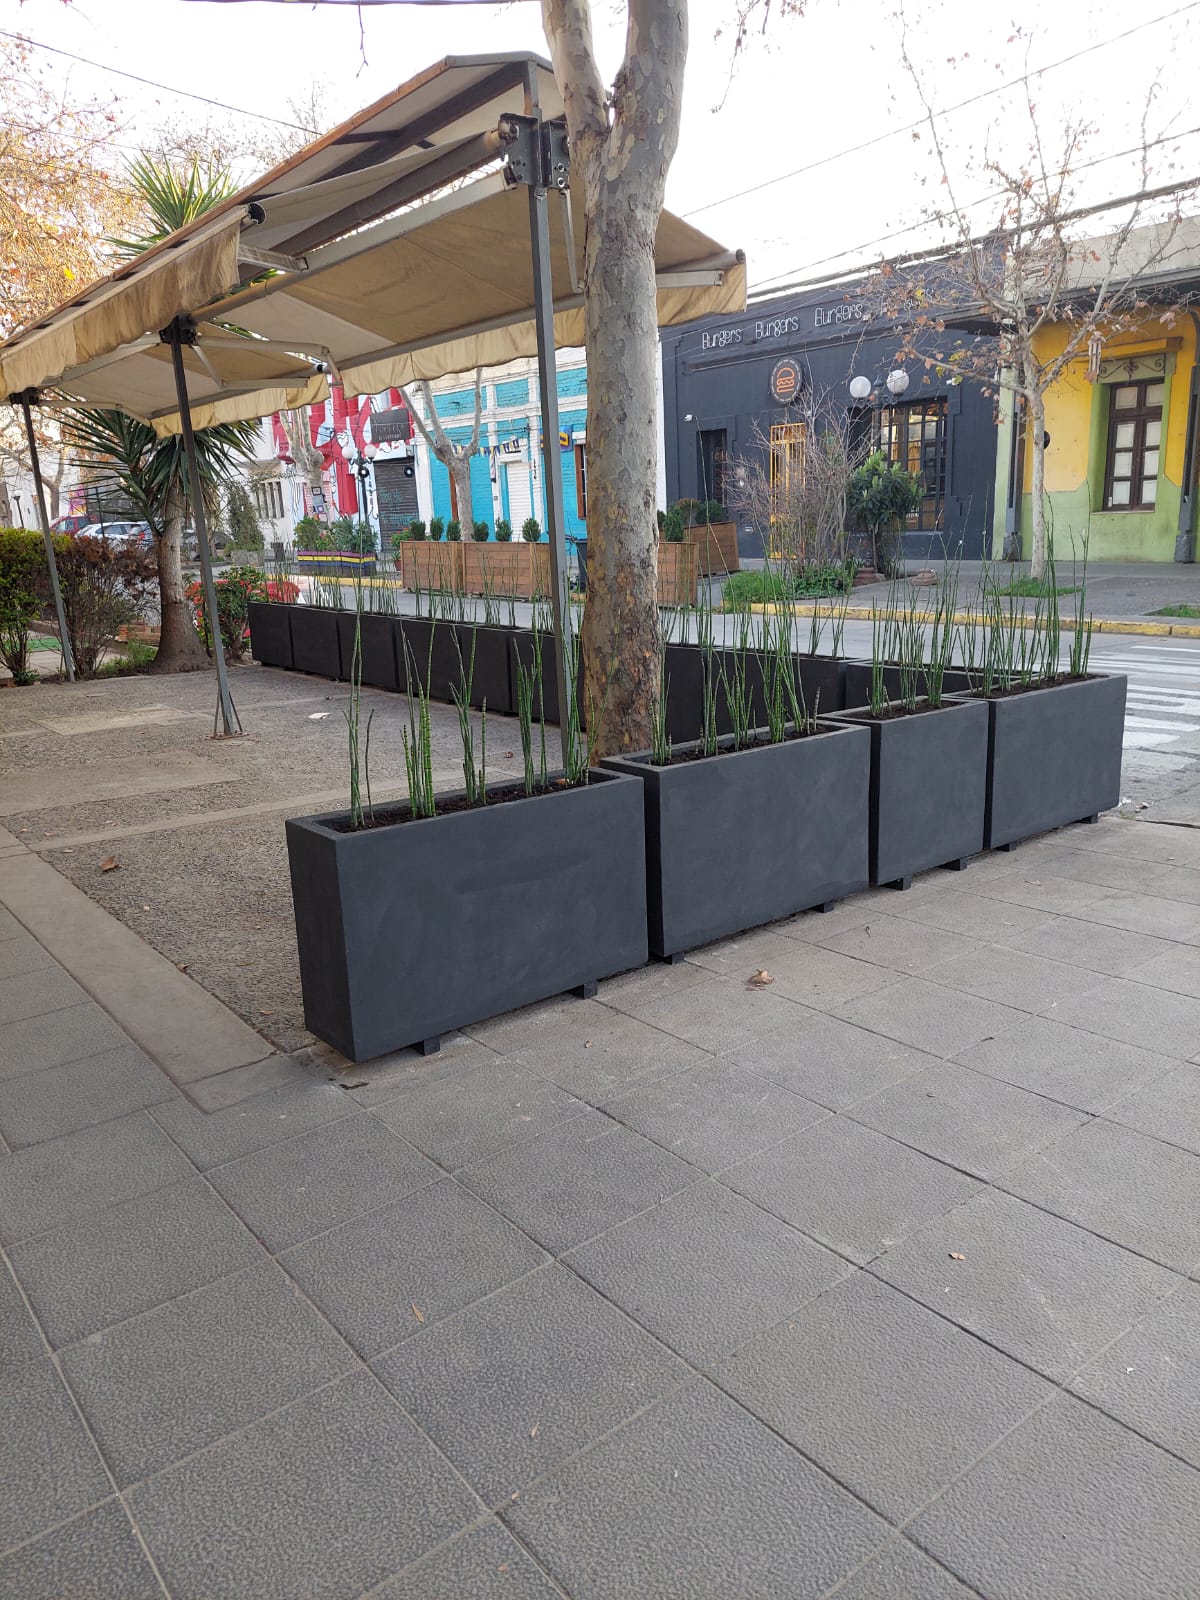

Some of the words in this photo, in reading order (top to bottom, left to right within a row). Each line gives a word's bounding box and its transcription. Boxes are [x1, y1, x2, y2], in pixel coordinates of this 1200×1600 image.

[702, 328, 742, 349] Burgers
[755, 316, 799, 339] Burgers
[814, 303, 863, 327] Burgers
